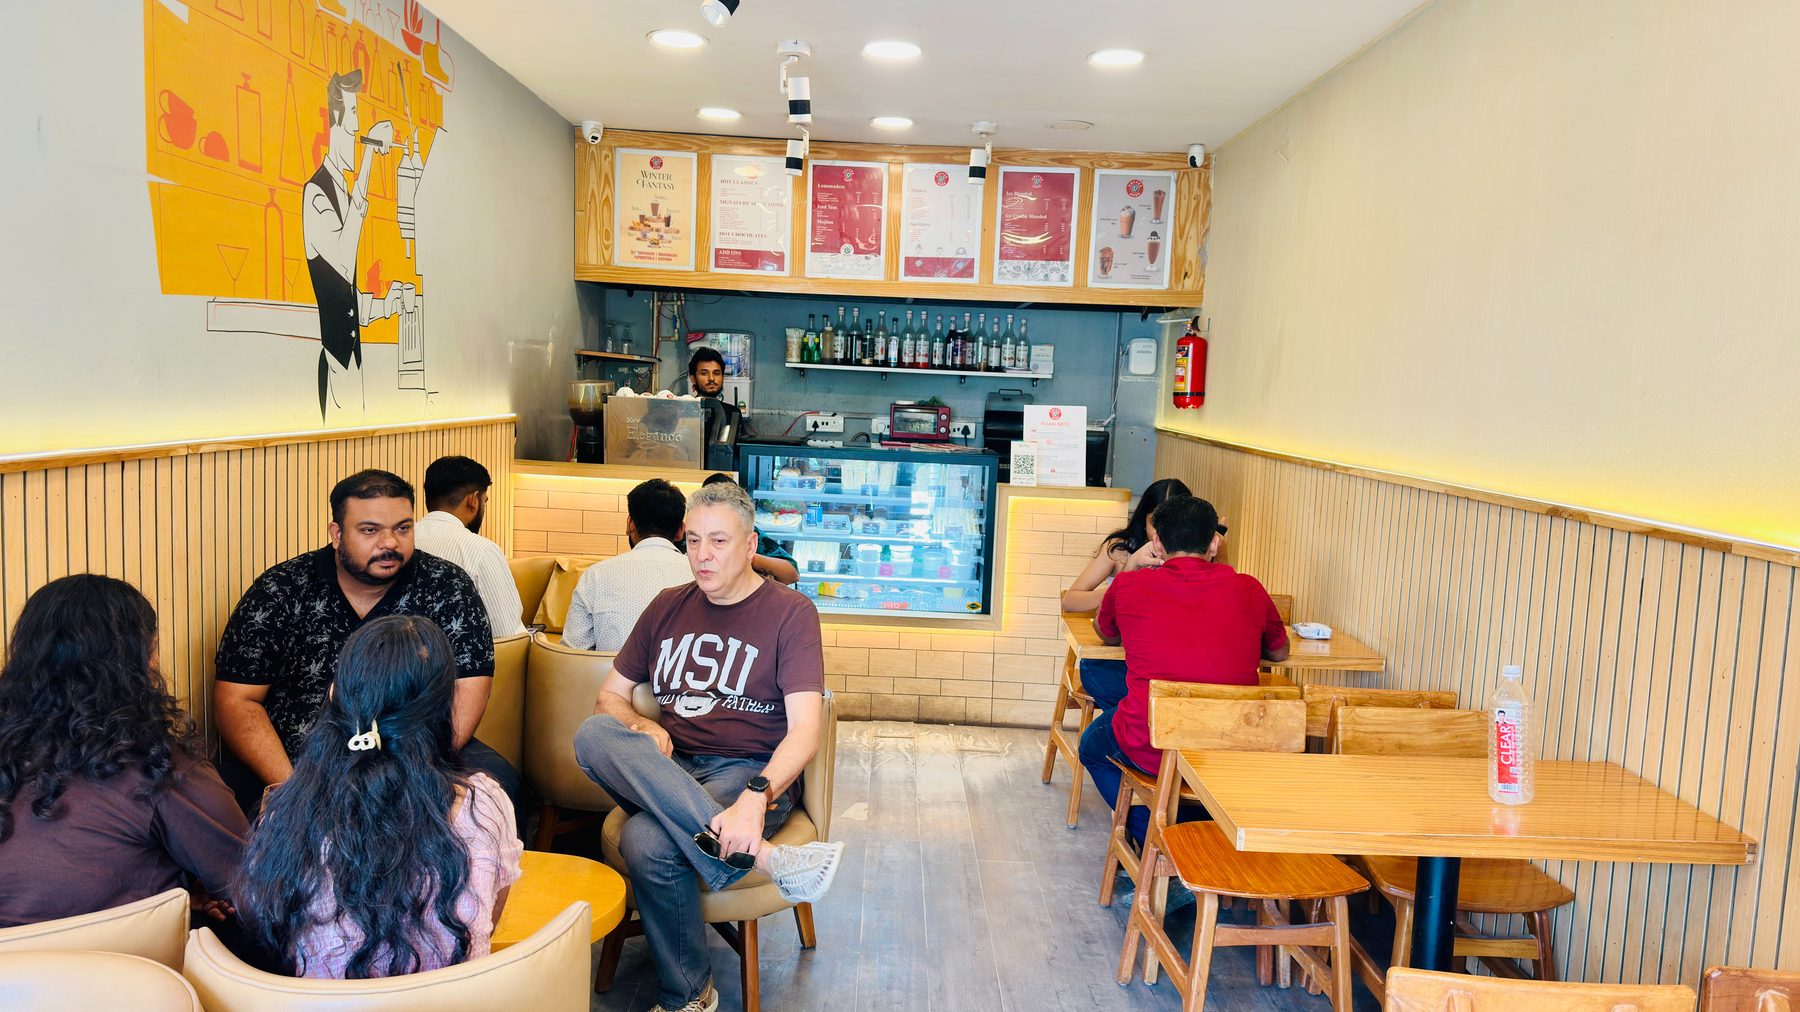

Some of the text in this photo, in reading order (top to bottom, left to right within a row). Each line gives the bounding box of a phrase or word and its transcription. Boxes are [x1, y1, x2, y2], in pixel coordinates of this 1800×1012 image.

[636, 179, 676, 191] FANTASY
[641, 170, 672, 181] WINTER
[653, 632, 759, 697] MSU
[1500, 725, 1512, 765] CLEAR
